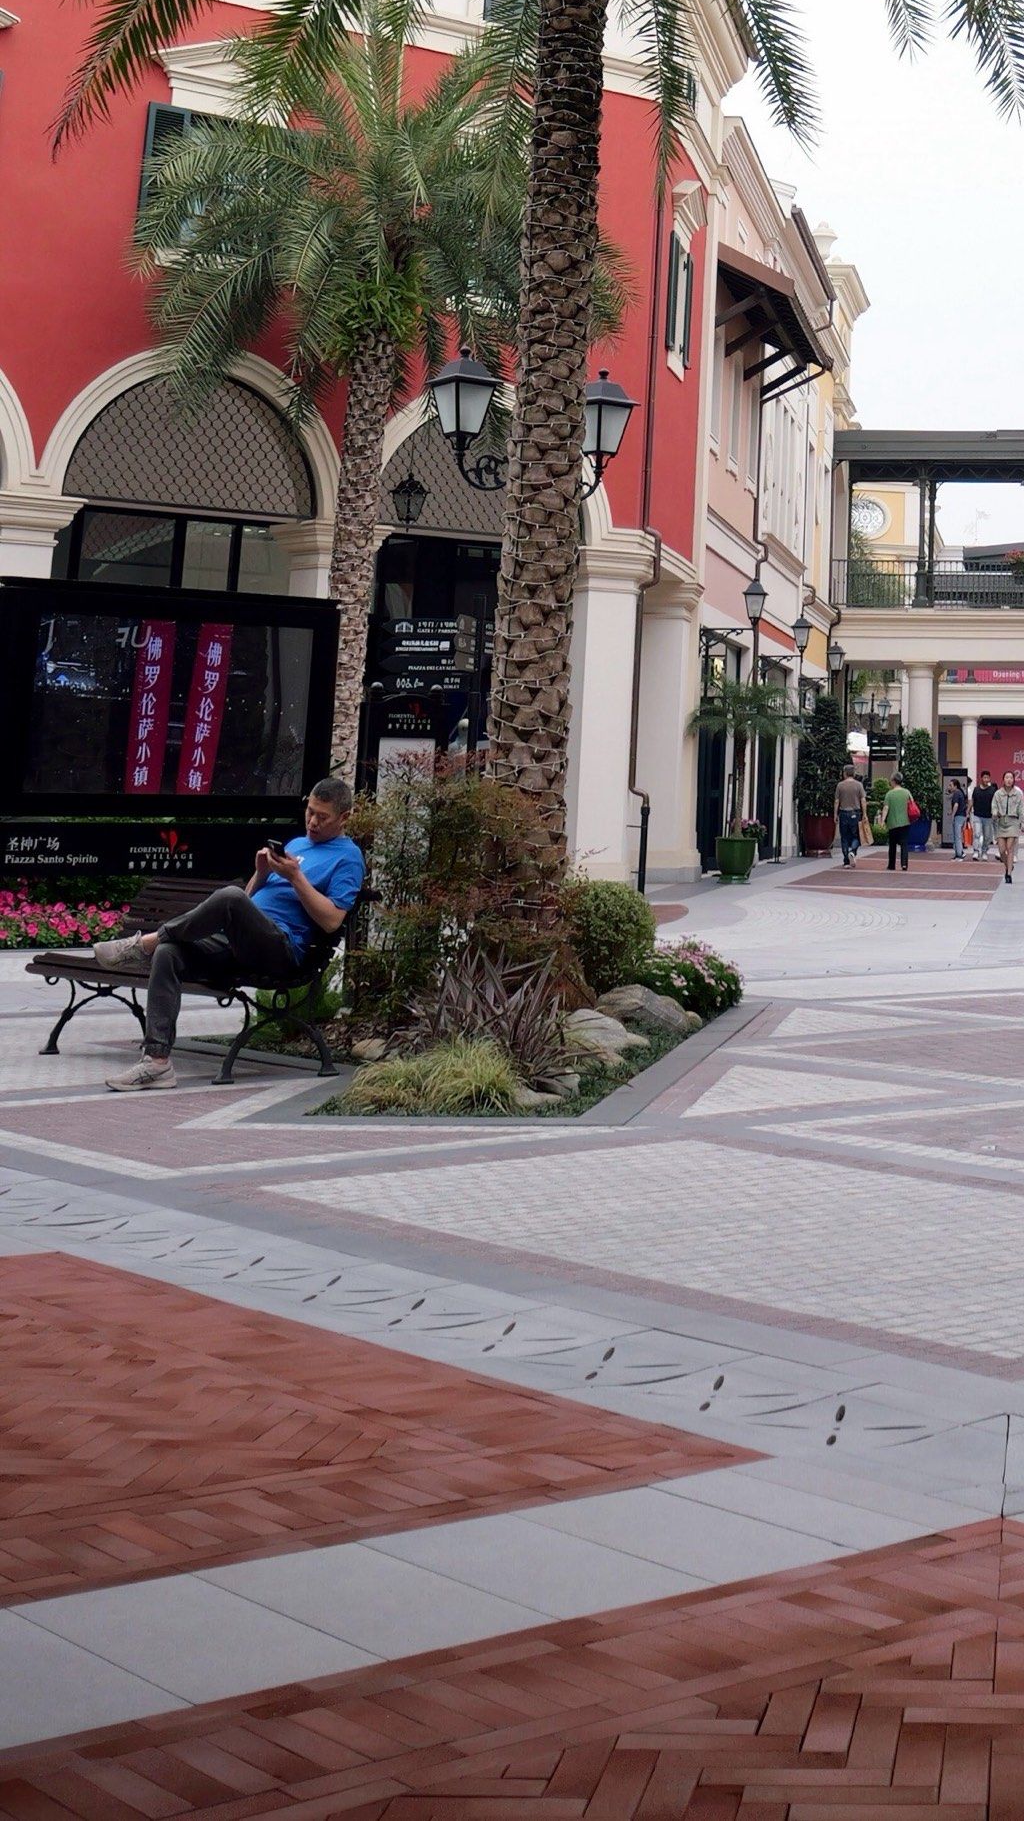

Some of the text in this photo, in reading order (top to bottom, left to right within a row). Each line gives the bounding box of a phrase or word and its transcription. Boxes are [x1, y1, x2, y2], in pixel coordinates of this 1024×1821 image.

[132, 635, 162, 787] 佛罗伦萨小镇
[188, 641, 222, 791] 佛罗伦萨小镇
[5, 854, 99, 866] Piazza Santo Spirito
[7, 836, 60, 851] 圣神广场
